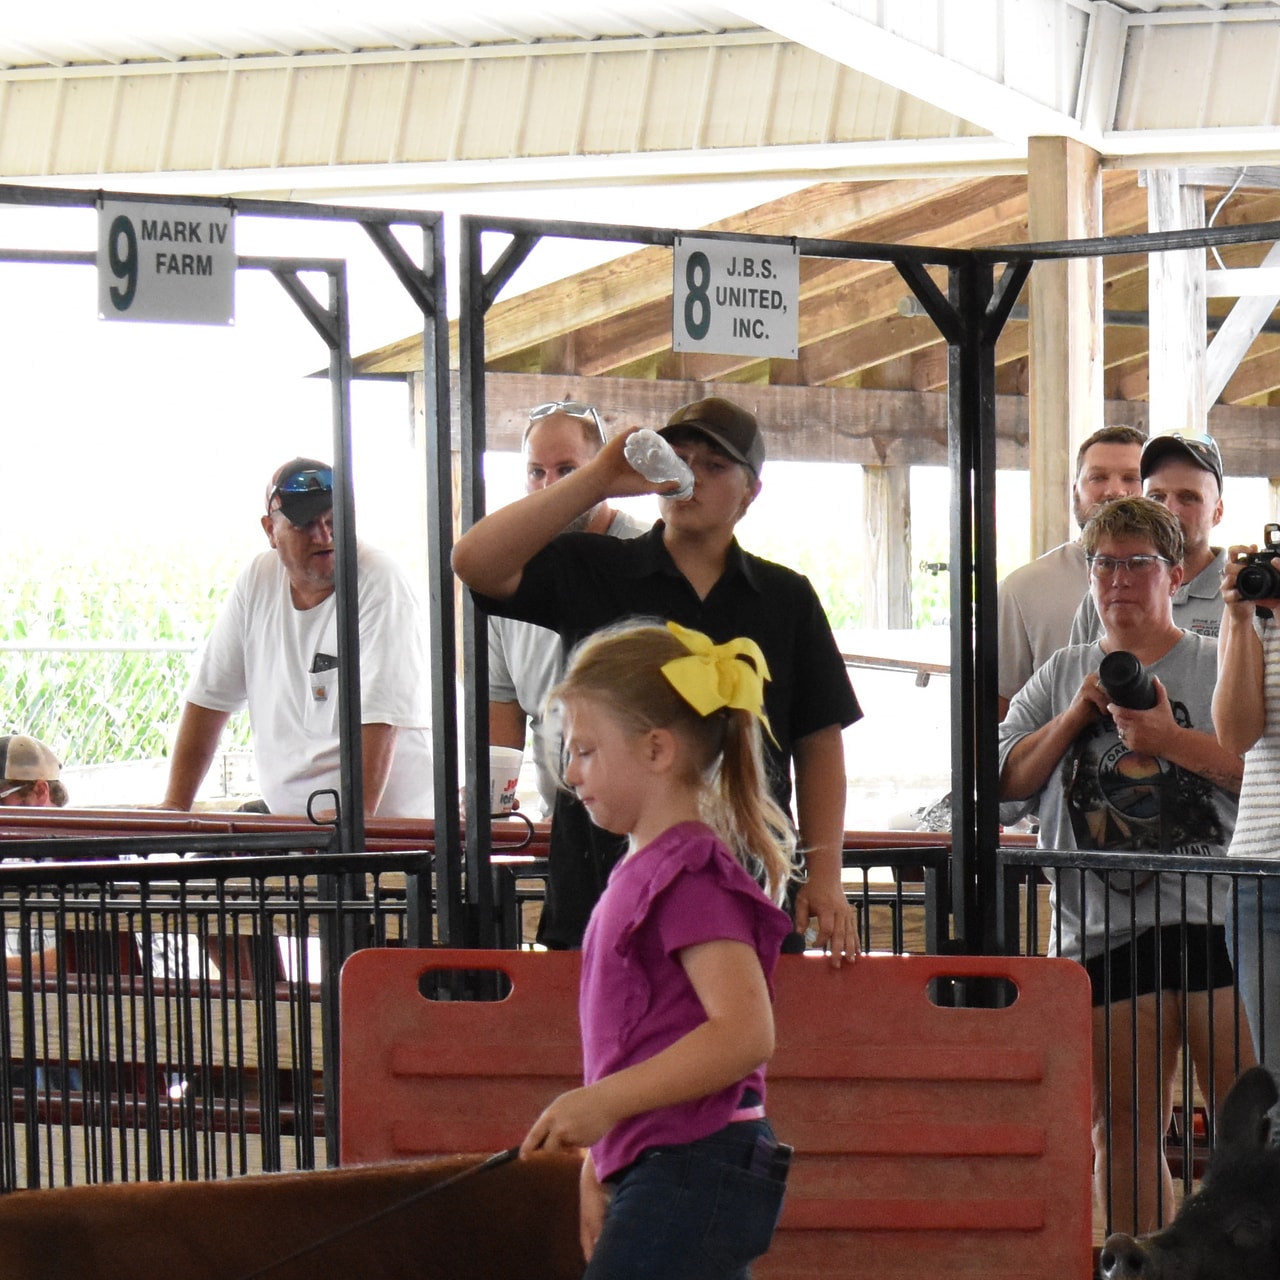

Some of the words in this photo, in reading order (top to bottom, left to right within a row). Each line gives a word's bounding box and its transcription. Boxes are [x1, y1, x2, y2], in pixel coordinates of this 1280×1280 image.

[141, 219, 202, 243] MARK
[209, 222, 228, 244] IV
[109, 214, 138, 312] 9
[156, 253, 212, 276] FARM
[726, 256, 777, 280] J.B.S.
[684, 251, 711, 341] 8
[715, 286, 787, 314] UNITED,
[732, 317, 769, 340] INC.
